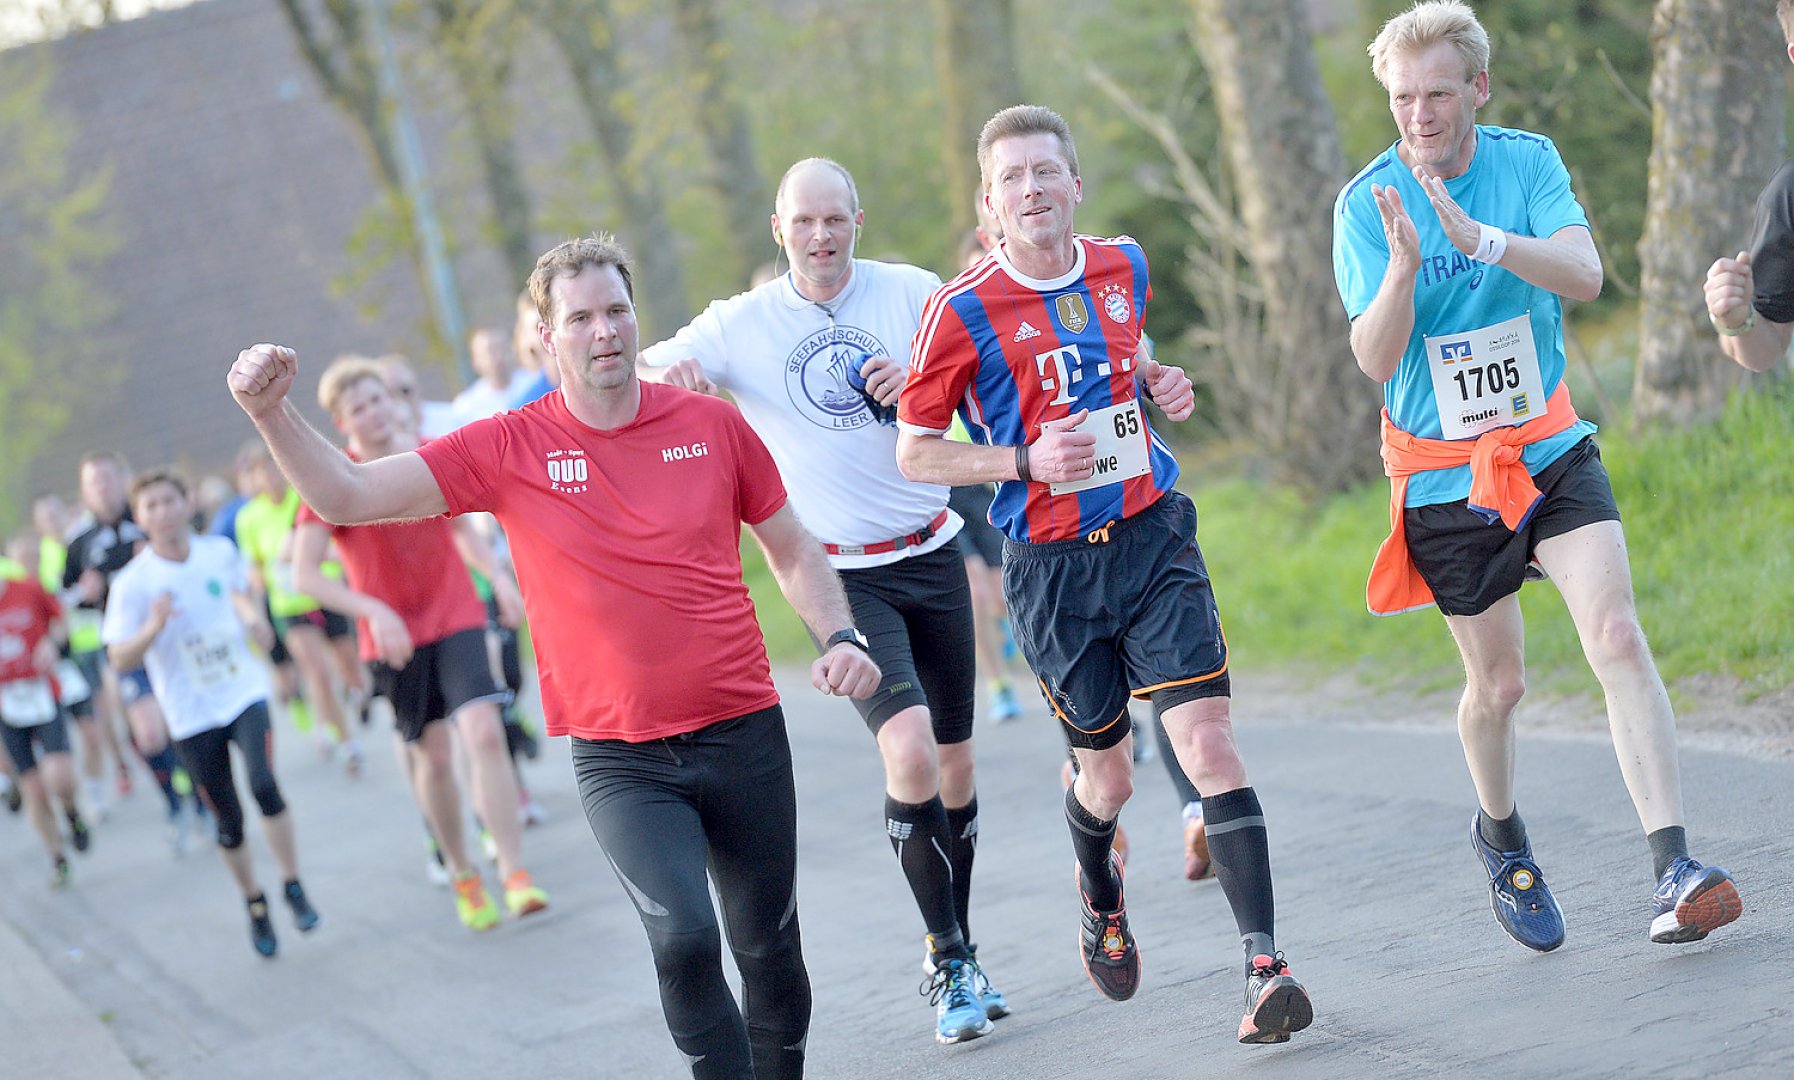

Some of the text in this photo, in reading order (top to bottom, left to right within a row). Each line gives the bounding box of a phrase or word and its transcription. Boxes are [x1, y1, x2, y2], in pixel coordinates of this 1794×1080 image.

[1422, 250, 1486, 288] TRAI
[1013, 330, 1042, 343] adidas
[1453, 357, 1520, 401] 1705
[833, 412, 869, 428] LEER
[1113, 409, 1139, 439] 65
[1462, 407, 1498, 424] multi
[661, 442, 709, 463] HOLGi
[1091, 455, 1118, 476] we
